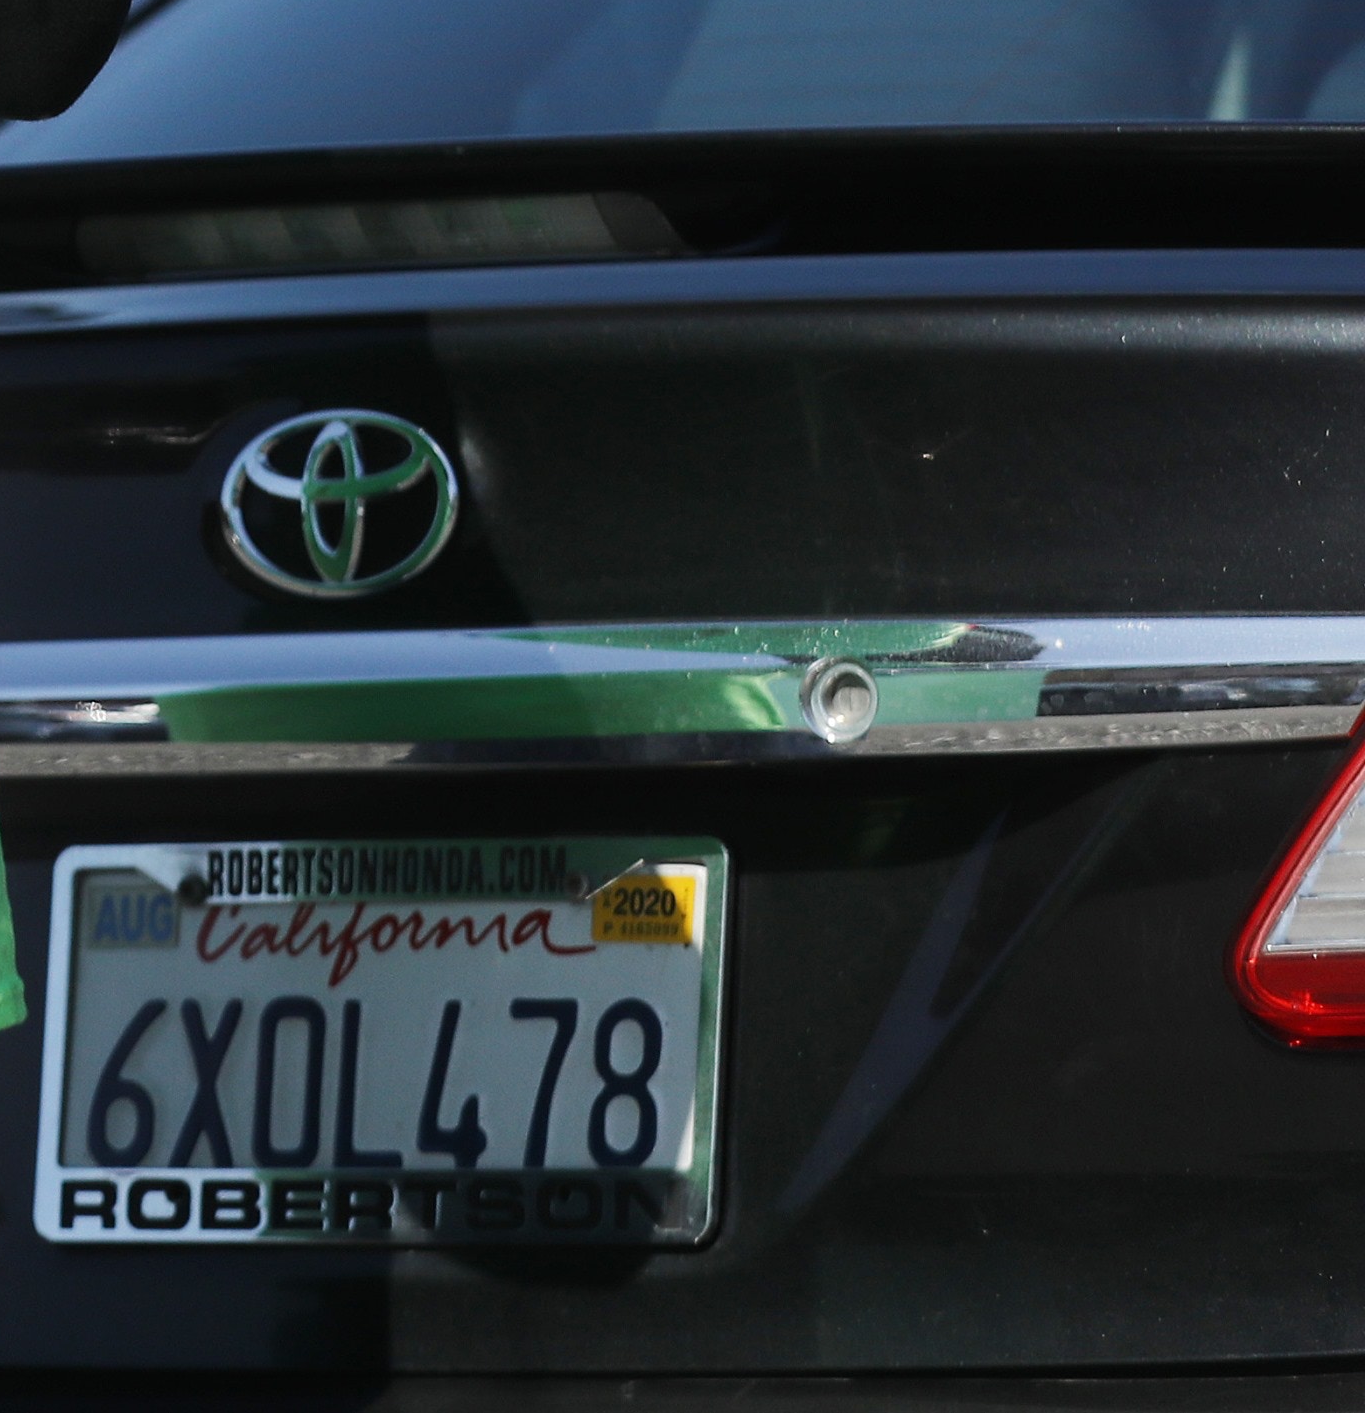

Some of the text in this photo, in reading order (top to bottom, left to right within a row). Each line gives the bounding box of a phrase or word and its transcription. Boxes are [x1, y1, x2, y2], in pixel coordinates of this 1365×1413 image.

[206, 845, 569, 897] ROBERTSONHONDA.COM
[93, 893, 173, 942] AUG
[613, 886, 677, 917] 2020
[195, 901, 597, 988] California
[58, 1177, 688, 1232] ROBERTSON
